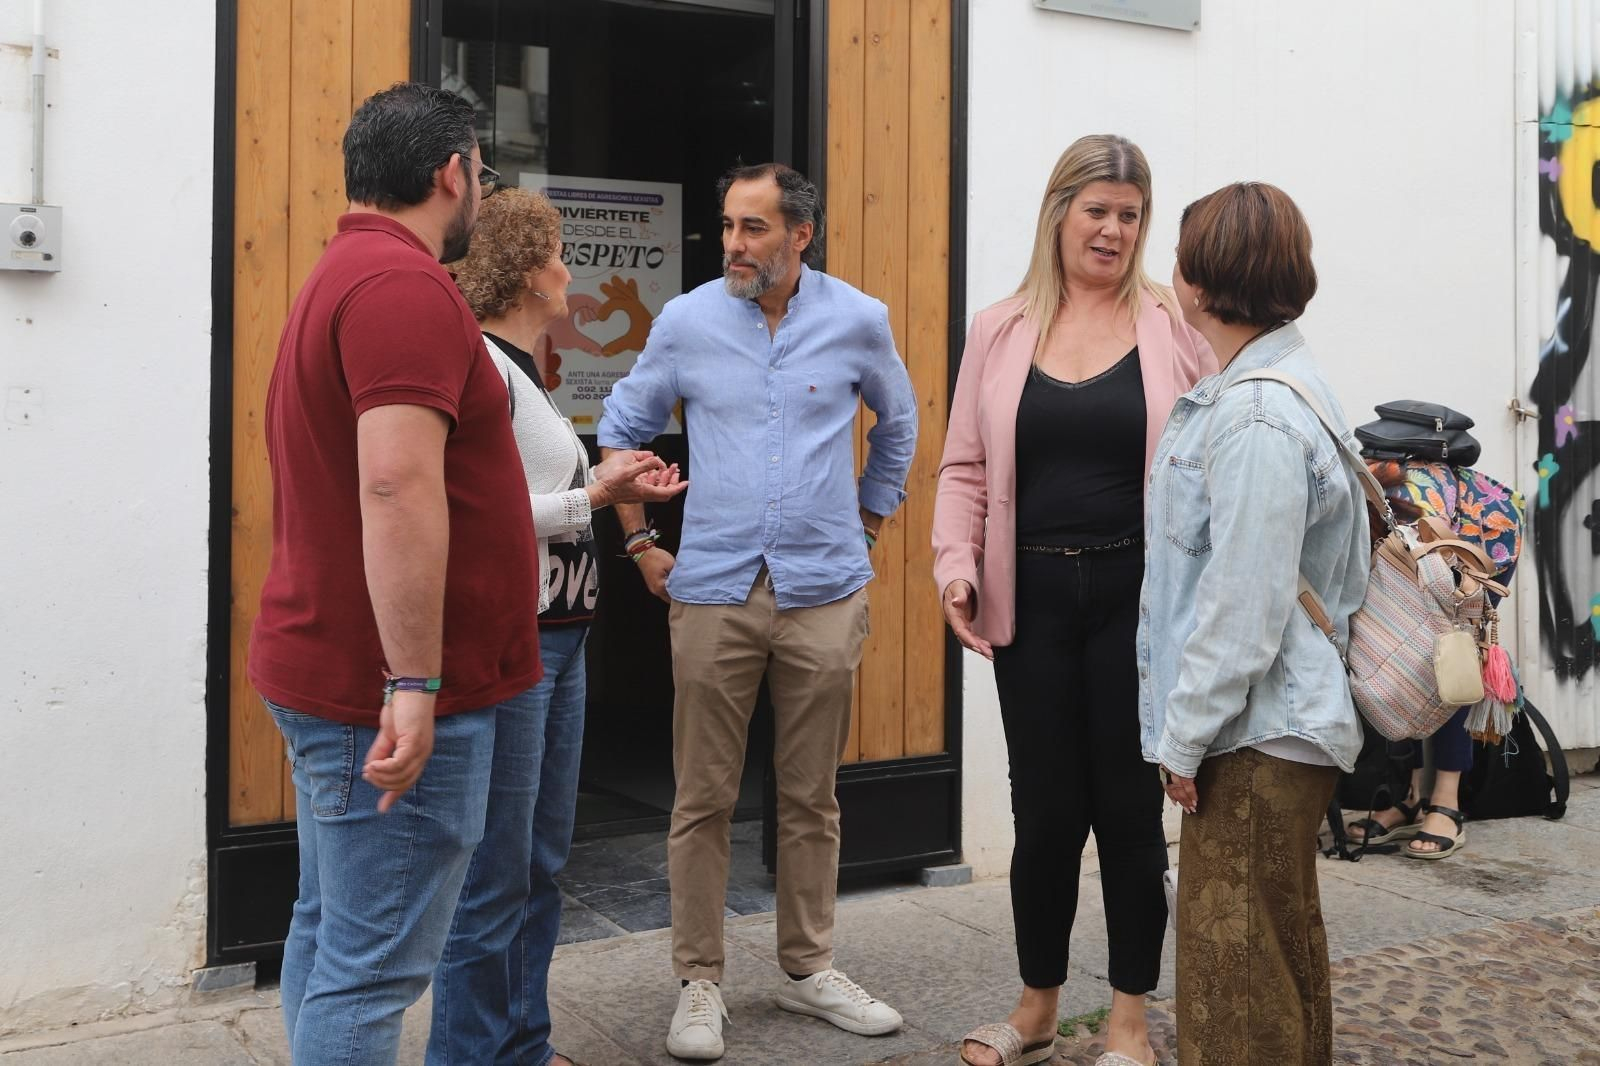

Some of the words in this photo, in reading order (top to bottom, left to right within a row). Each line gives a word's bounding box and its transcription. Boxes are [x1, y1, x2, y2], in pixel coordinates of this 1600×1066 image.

[563, 223, 617, 238] DESDE
[620, 227, 637, 239] EL
[560, 242, 665, 269] ESPETO
